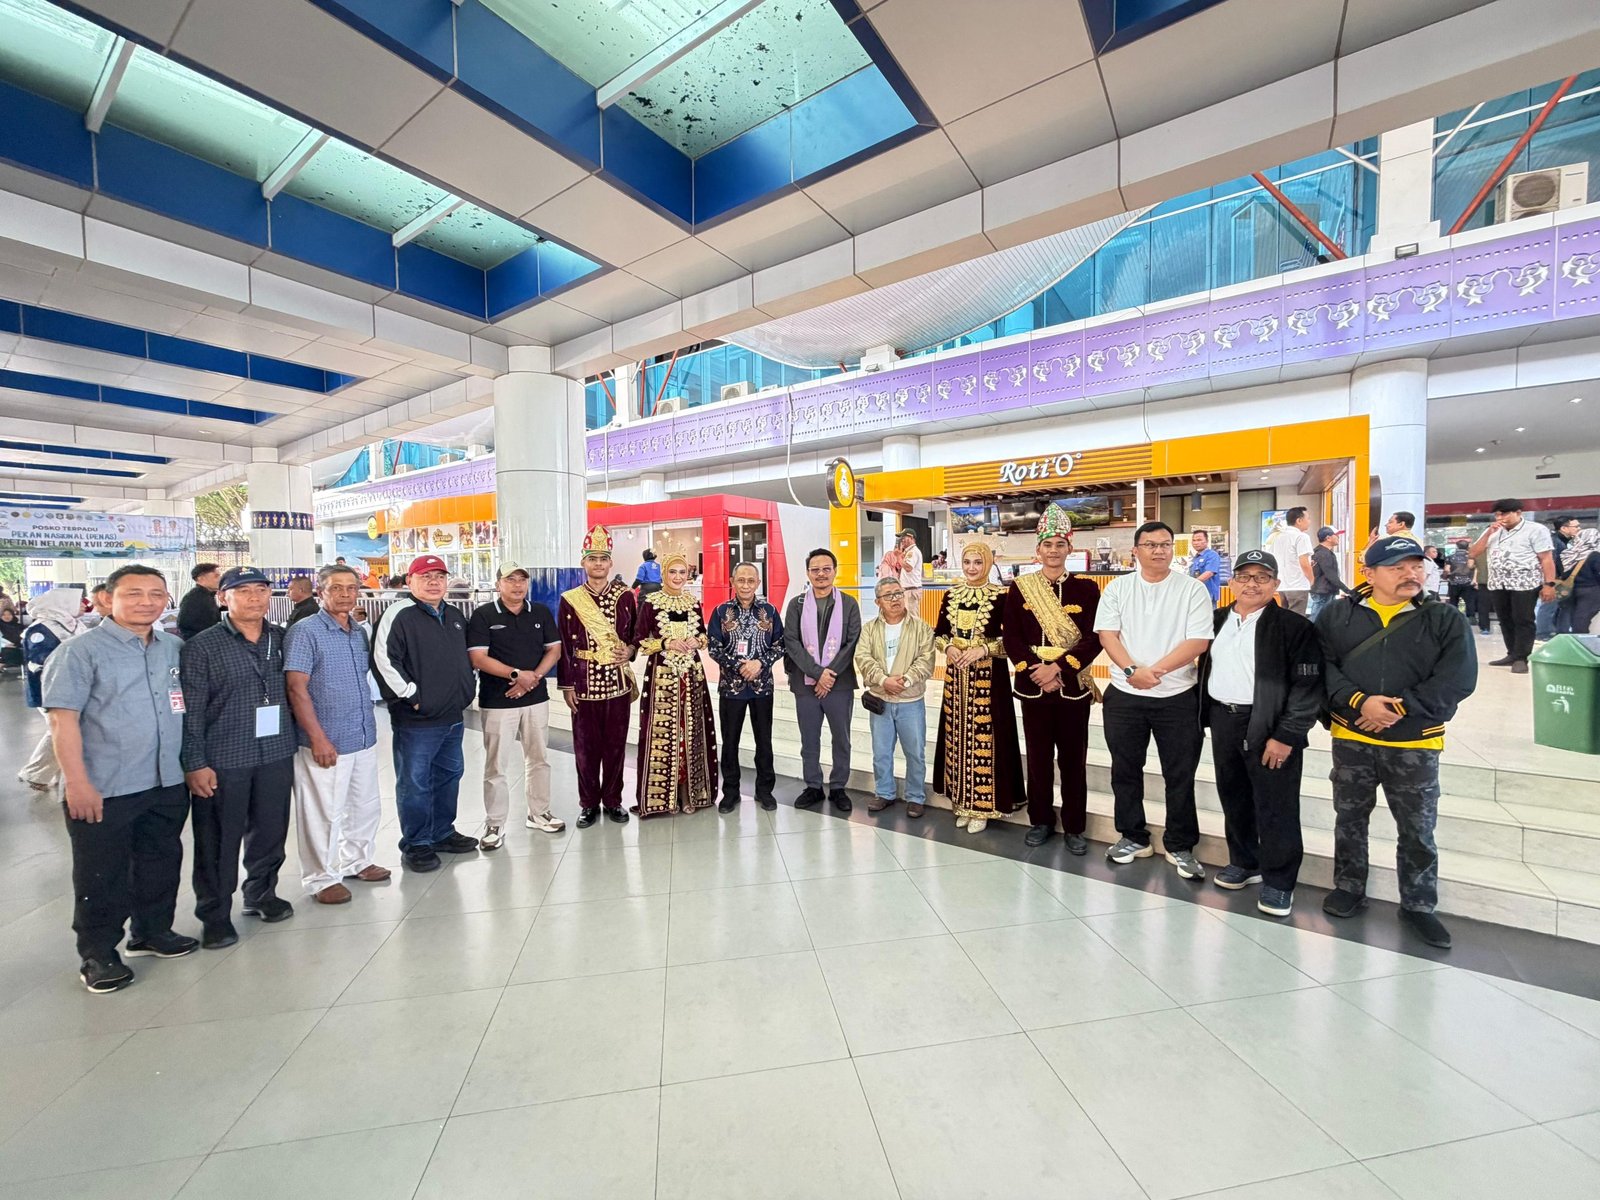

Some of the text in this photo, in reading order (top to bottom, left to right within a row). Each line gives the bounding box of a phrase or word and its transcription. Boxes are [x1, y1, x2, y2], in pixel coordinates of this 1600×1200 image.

[999, 453, 1074, 486] Roti'O
[11, 530, 117, 541] PEKAN NASIONAL (PENAS)
